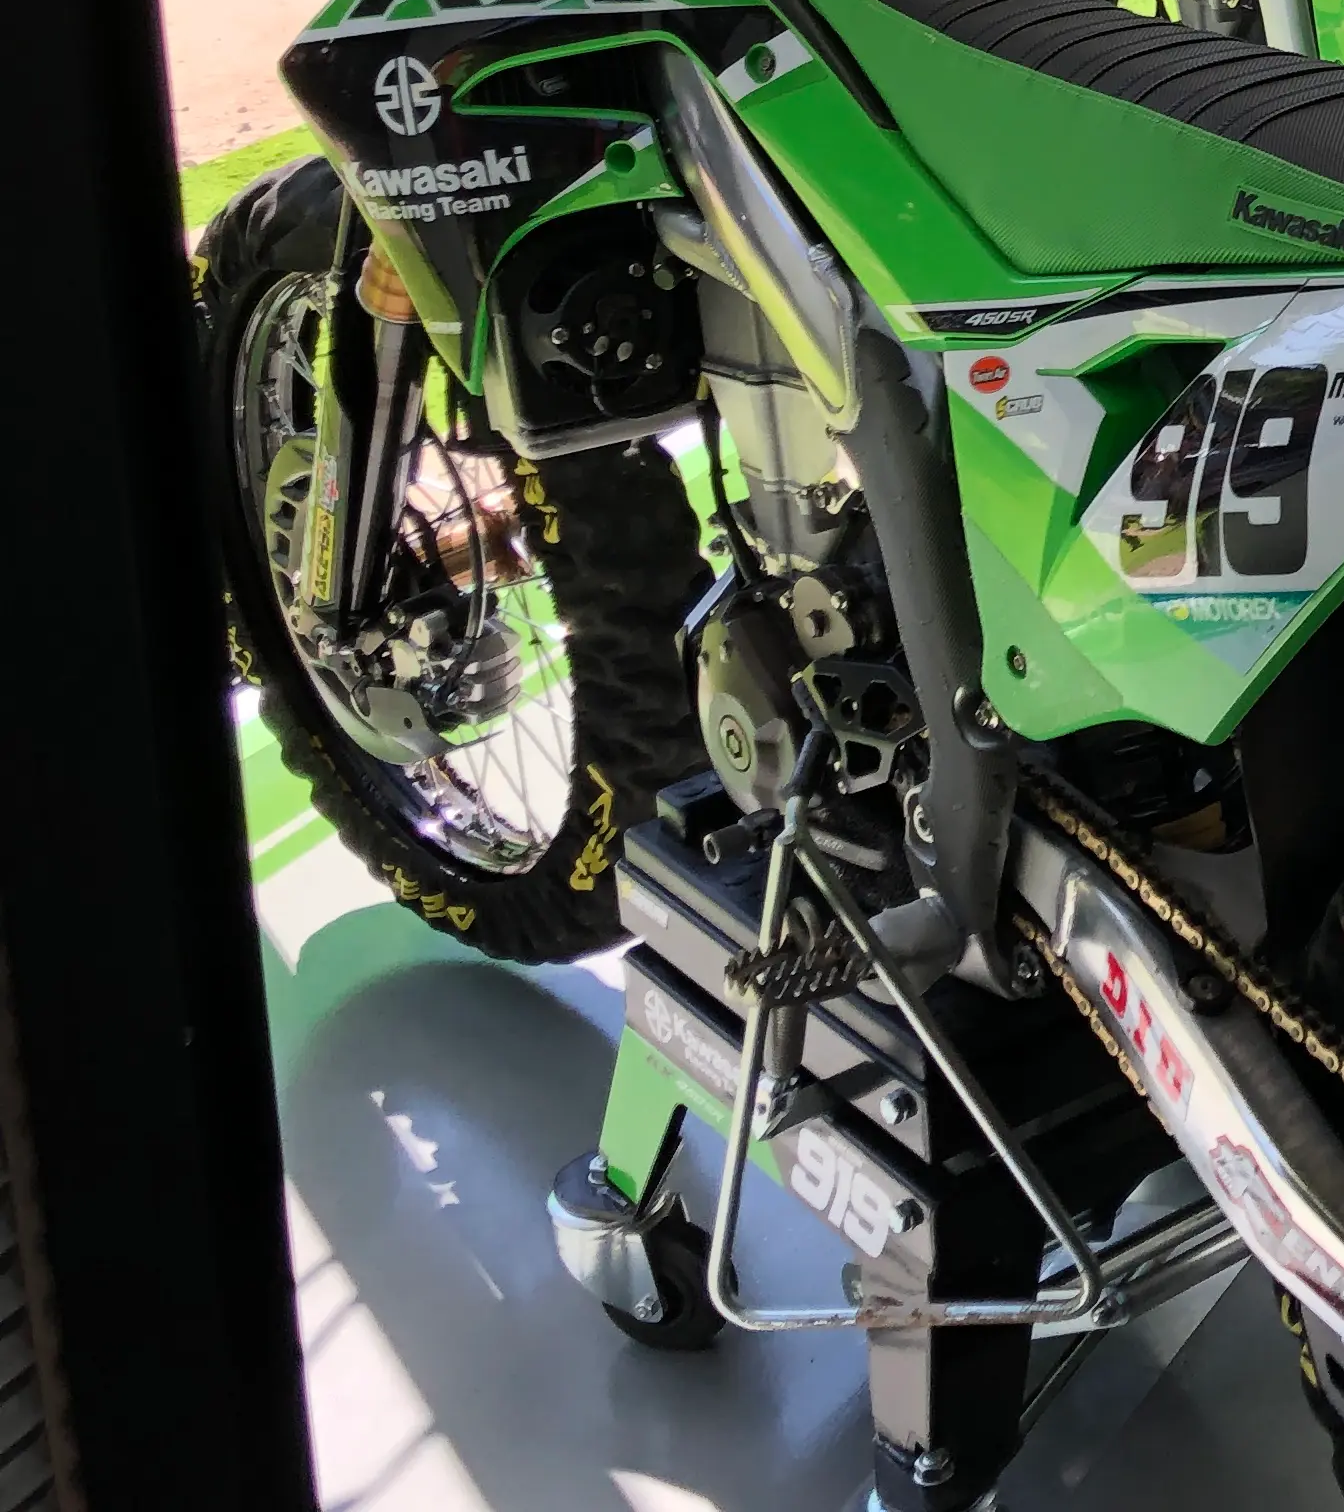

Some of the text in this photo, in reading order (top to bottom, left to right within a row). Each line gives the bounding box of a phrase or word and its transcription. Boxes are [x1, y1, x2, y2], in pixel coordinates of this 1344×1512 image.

[340, 144, 532, 199] Kawasaki
[366, 191, 511, 224] Racing Team
[964, 308, 1037, 328] 450SR
[1191, 597, 1281, 622] MOTOREX
[790, 1126, 893, 1260] 919
